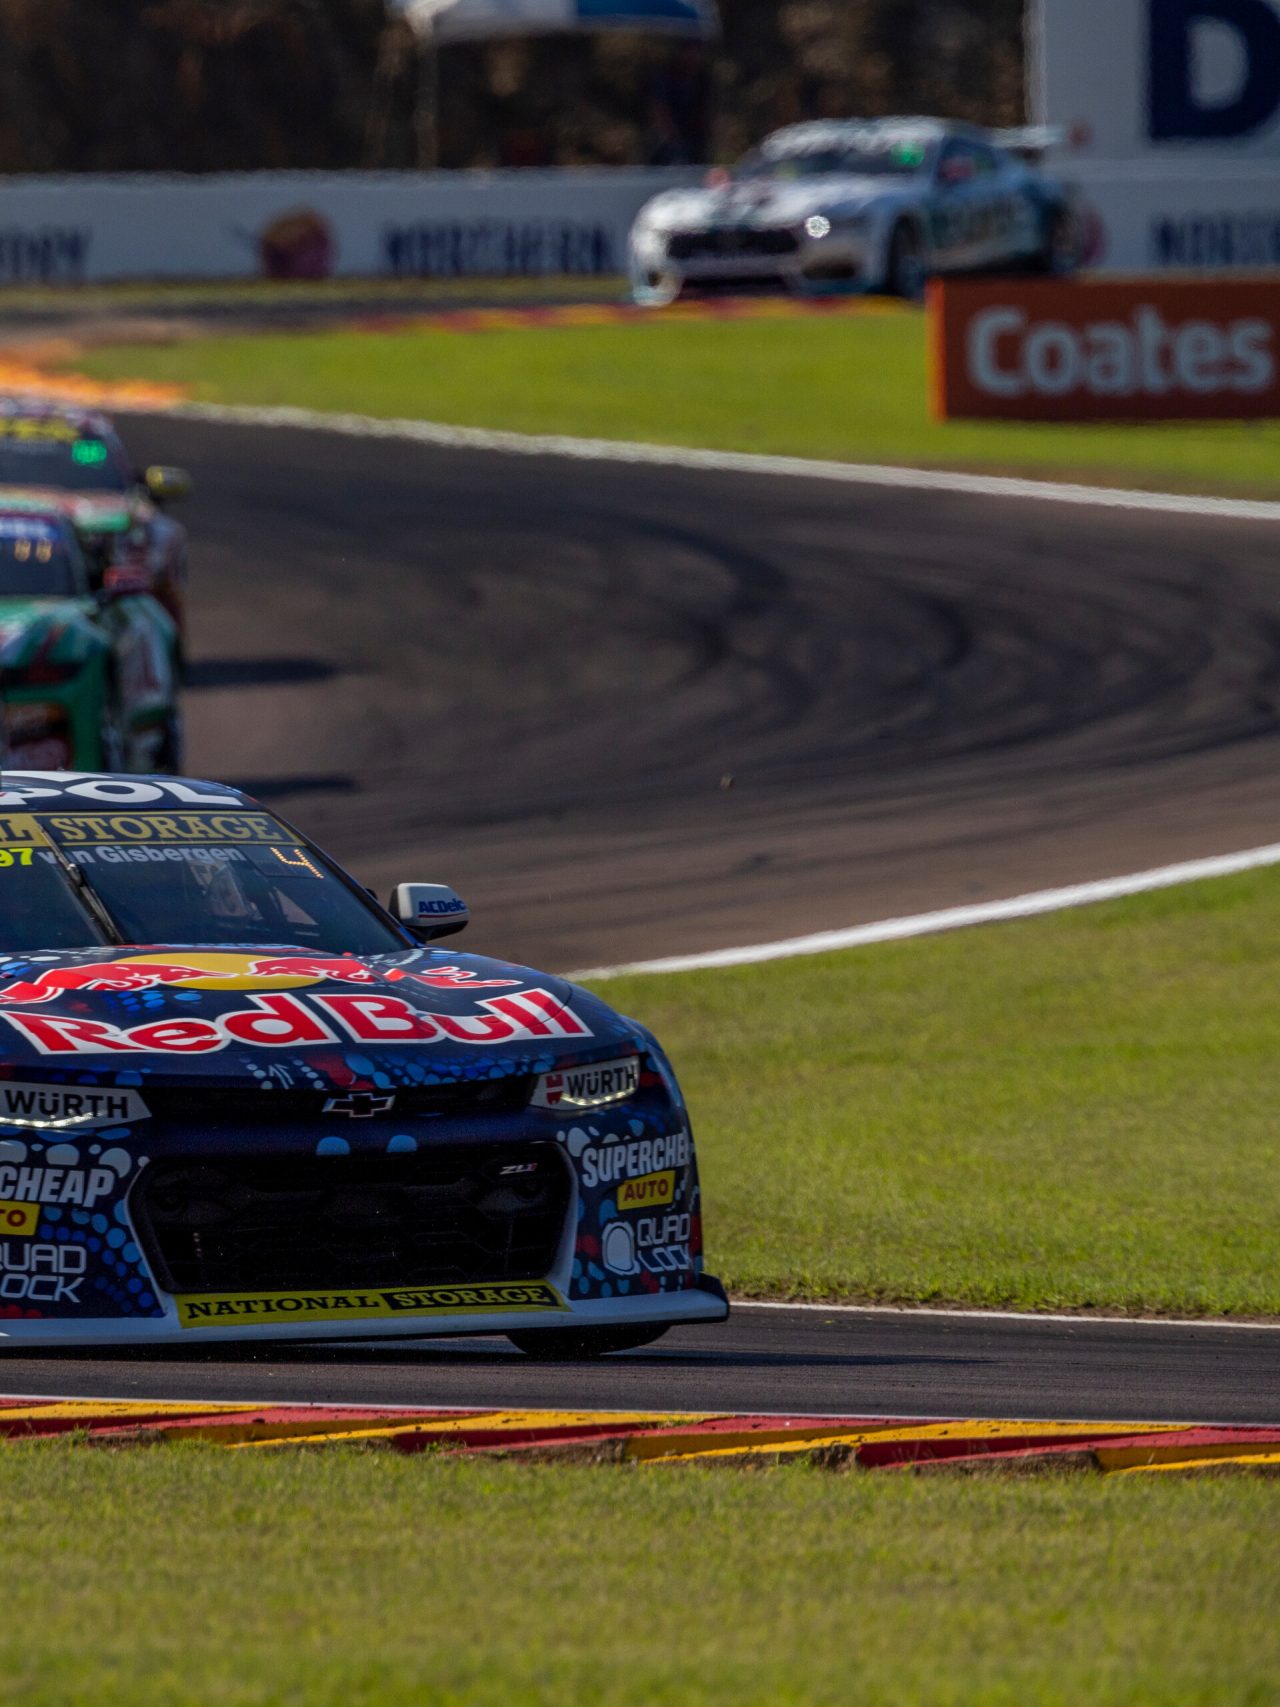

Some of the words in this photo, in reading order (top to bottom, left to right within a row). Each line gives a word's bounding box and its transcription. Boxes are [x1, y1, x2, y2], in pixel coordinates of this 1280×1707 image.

[966, 304, 1274, 396] Coates
[54, 814, 280, 843] STORAGE
[36, 850, 96, 866] vn
[96, 846, 251, 864] Gisbergen
[270, 847, 325, 879] 4
[418, 898, 467, 913] ACDelc
[309, 987, 594, 1044] Bull
[581, 1132, 690, 1188] SUPERCHE
[623, 1178, 669, 1201] AUTO
[636, 1213, 691, 1247] QUAD
[637, 1243, 694, 1272] LOC
[186, 1295, 381, 1320] NATIONAL
[391, 1286, 550, 1311] STORAGE
